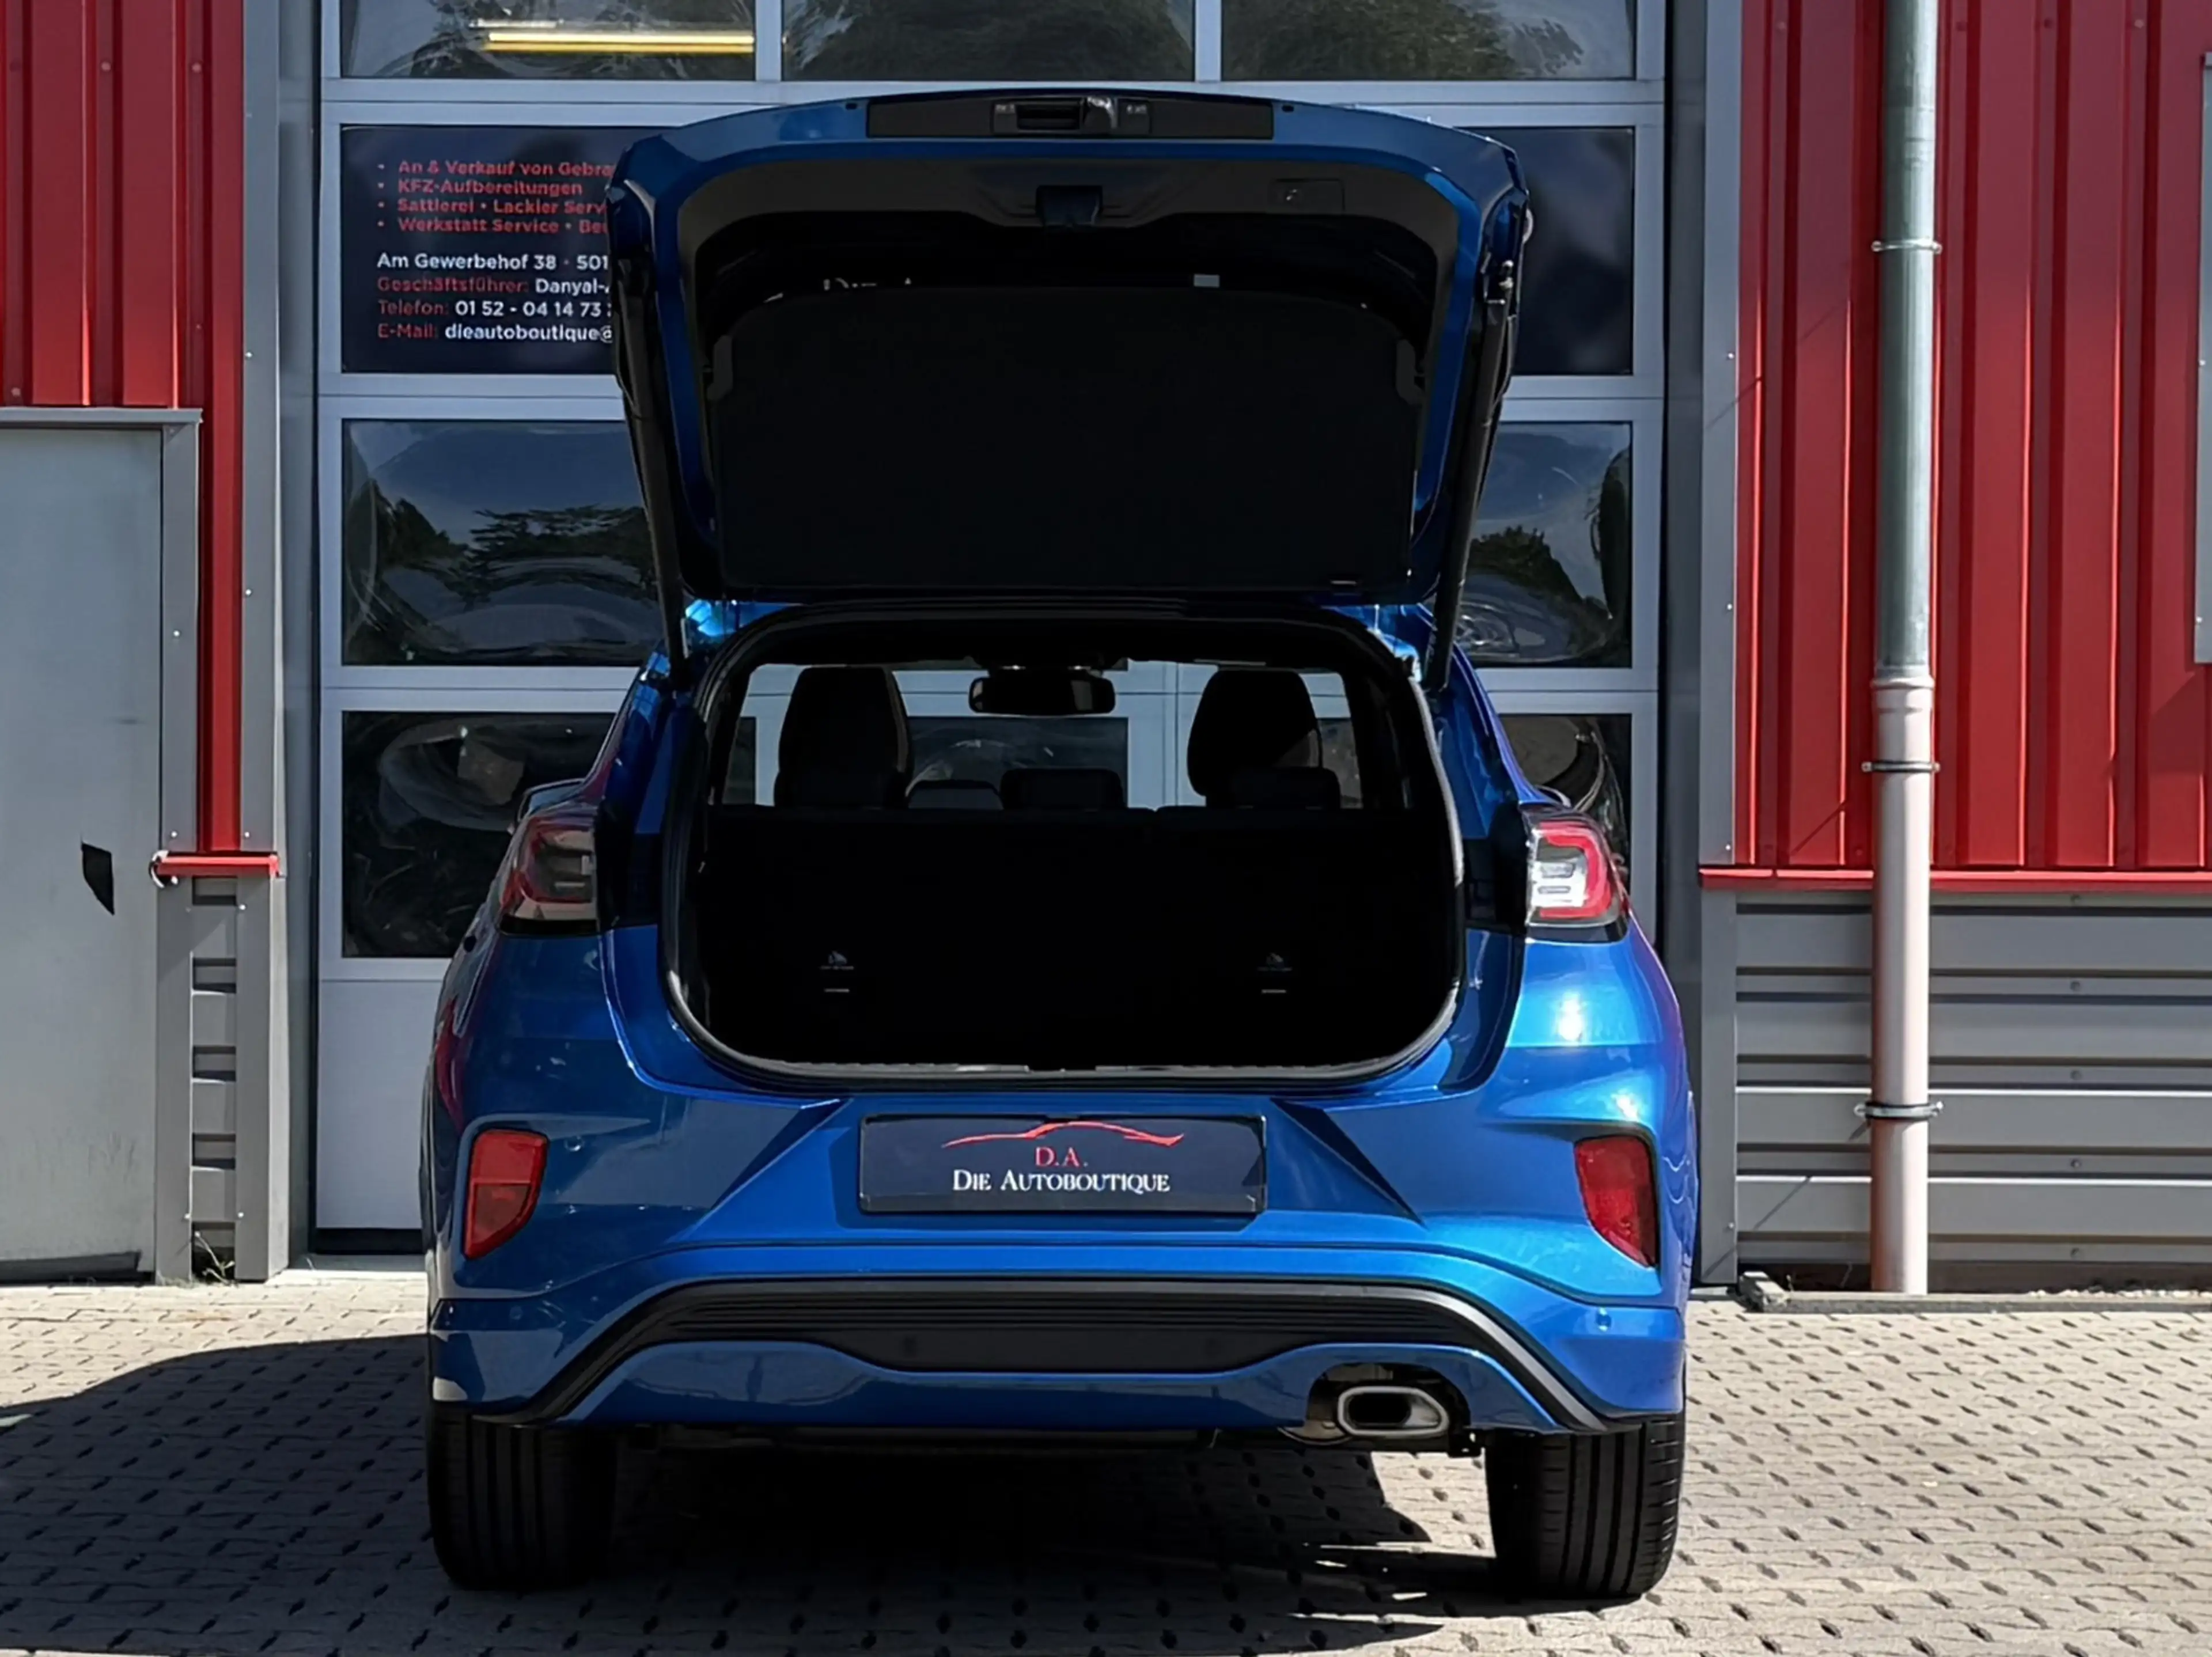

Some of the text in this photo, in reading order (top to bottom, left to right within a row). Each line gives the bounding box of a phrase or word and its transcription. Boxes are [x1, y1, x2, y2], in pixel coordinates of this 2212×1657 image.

[398, 160, 422, 174] An
[427, 160, 439, 175] &
[445, 160, 514, 175] Verkauf
[520, 164, 554, 176] von
[397, 179, 583, 197] KFZ-Aufbereitungen
[397, 198, 475, 213] Sattlerei
[493, 199, 559, 215] Lackier
[397, 217, 487, 232] Werkstatt
[492, 219, 559, 234] Service
[377, 252, 408, 268] Am
[414, 252, 529, 270] Gewerbehof
[533, 255, 556, 269] 38
[377, 276, 529, 292] Geschäftsführer:
[378, 299, 448, 315] Telefon:
[455, 301, 475, 315] 01
[482, 301, 504, 316] 52
[522, 302, 548, 316] 04
[554, 302, 574, 317] 14
[579, 302, 601, 317] 73
[378, 323, 438, 339] E-Mail:
